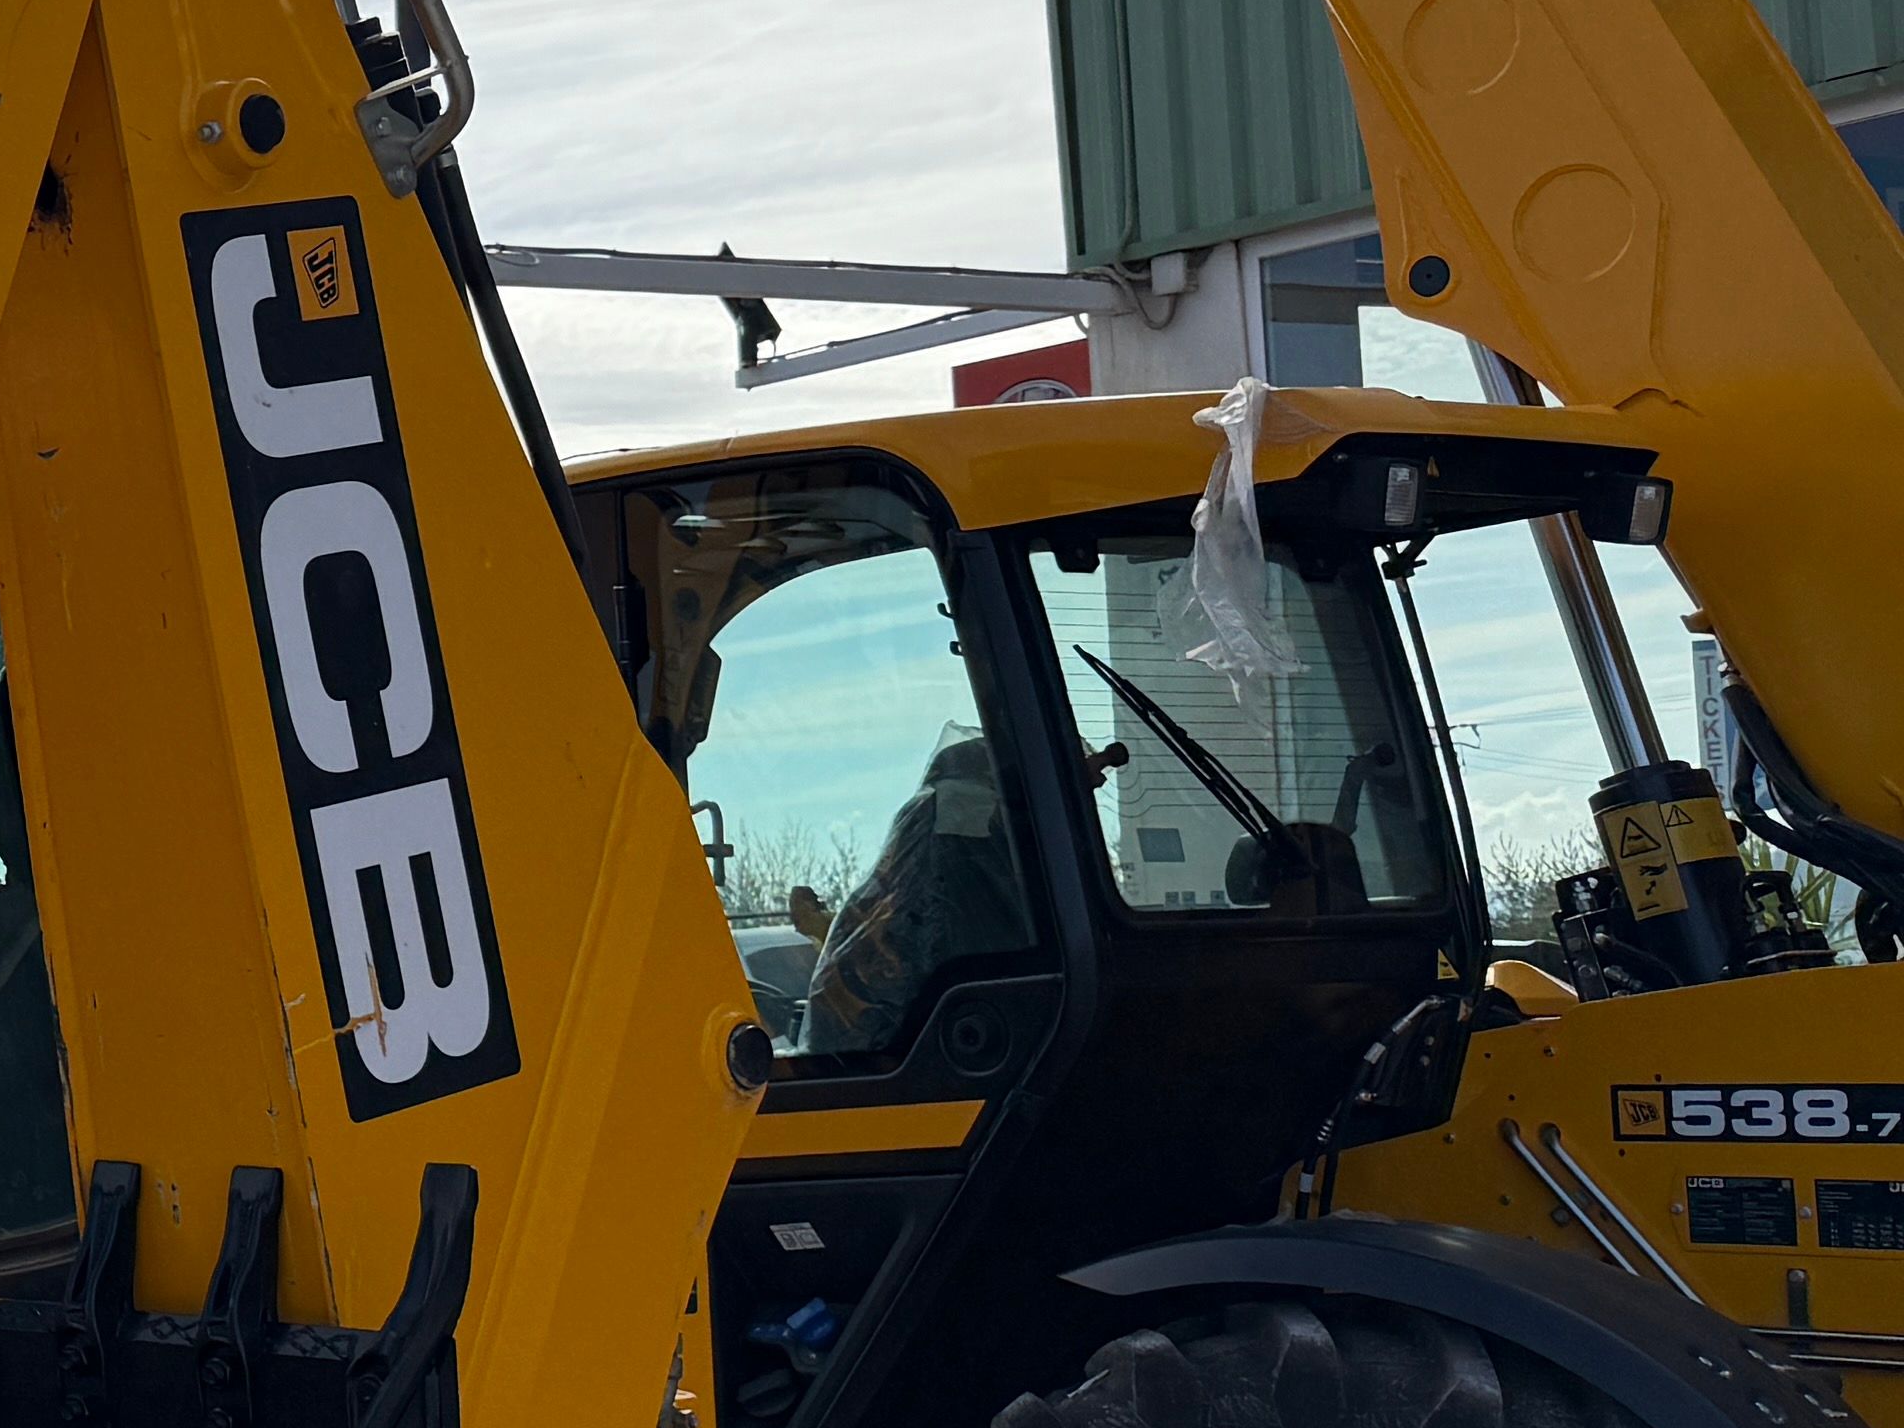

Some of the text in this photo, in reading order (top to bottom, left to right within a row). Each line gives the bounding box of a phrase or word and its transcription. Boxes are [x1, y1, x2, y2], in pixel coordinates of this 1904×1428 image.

[307, 248, 338, 303] JCB
[210, 234, 491, 1086] JCB
[1629, 1101, 1659, 1124] JCB
[1687, 1177, 1725, 1189] JCB
